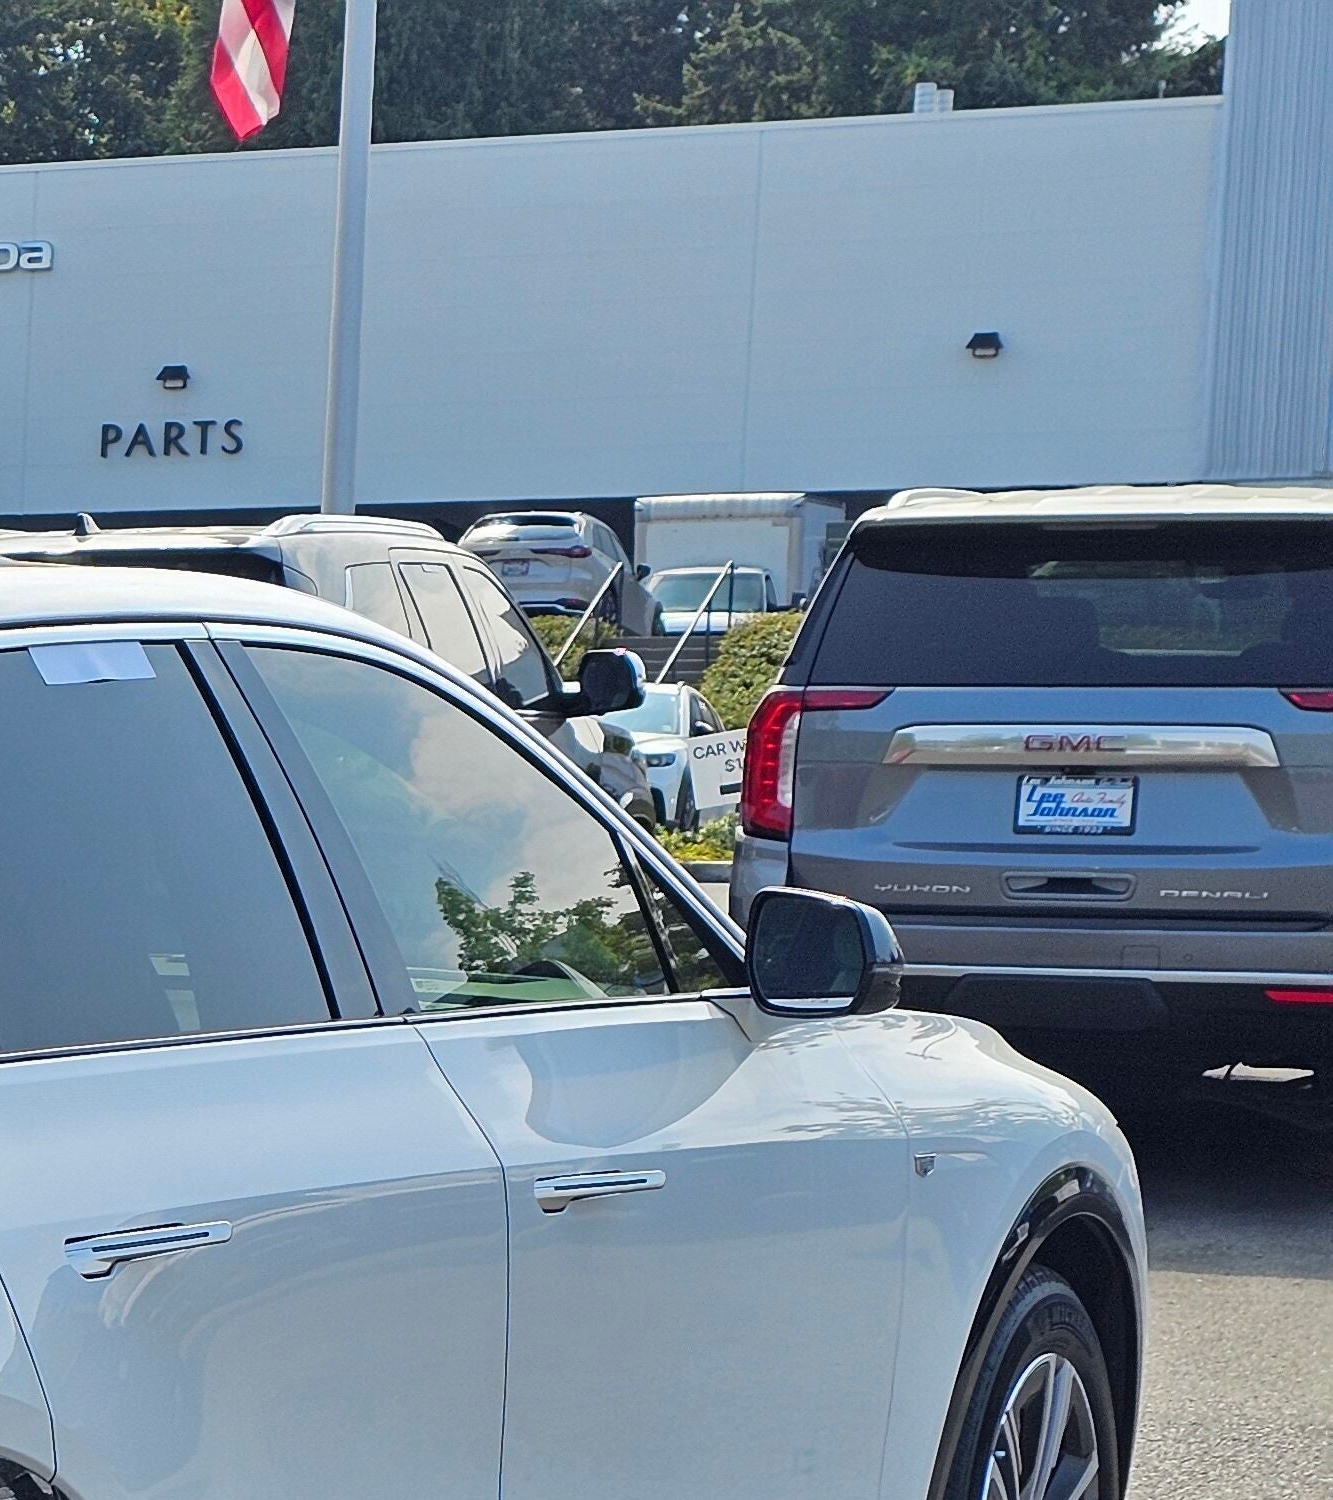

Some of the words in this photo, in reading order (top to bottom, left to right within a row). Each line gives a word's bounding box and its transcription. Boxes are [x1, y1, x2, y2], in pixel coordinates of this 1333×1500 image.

[100, 418, 244, 458] PARTS
[693, 742, 726, 759] CAR
[1024, 734, 1125, 752] GMC
[1026, 785, 1066, 802] Lee
[1026, 800, 1118, 818] Johnson
[874, 884, 971, 893] YUKON
[1159, 889, 1268, 899] DENALI
